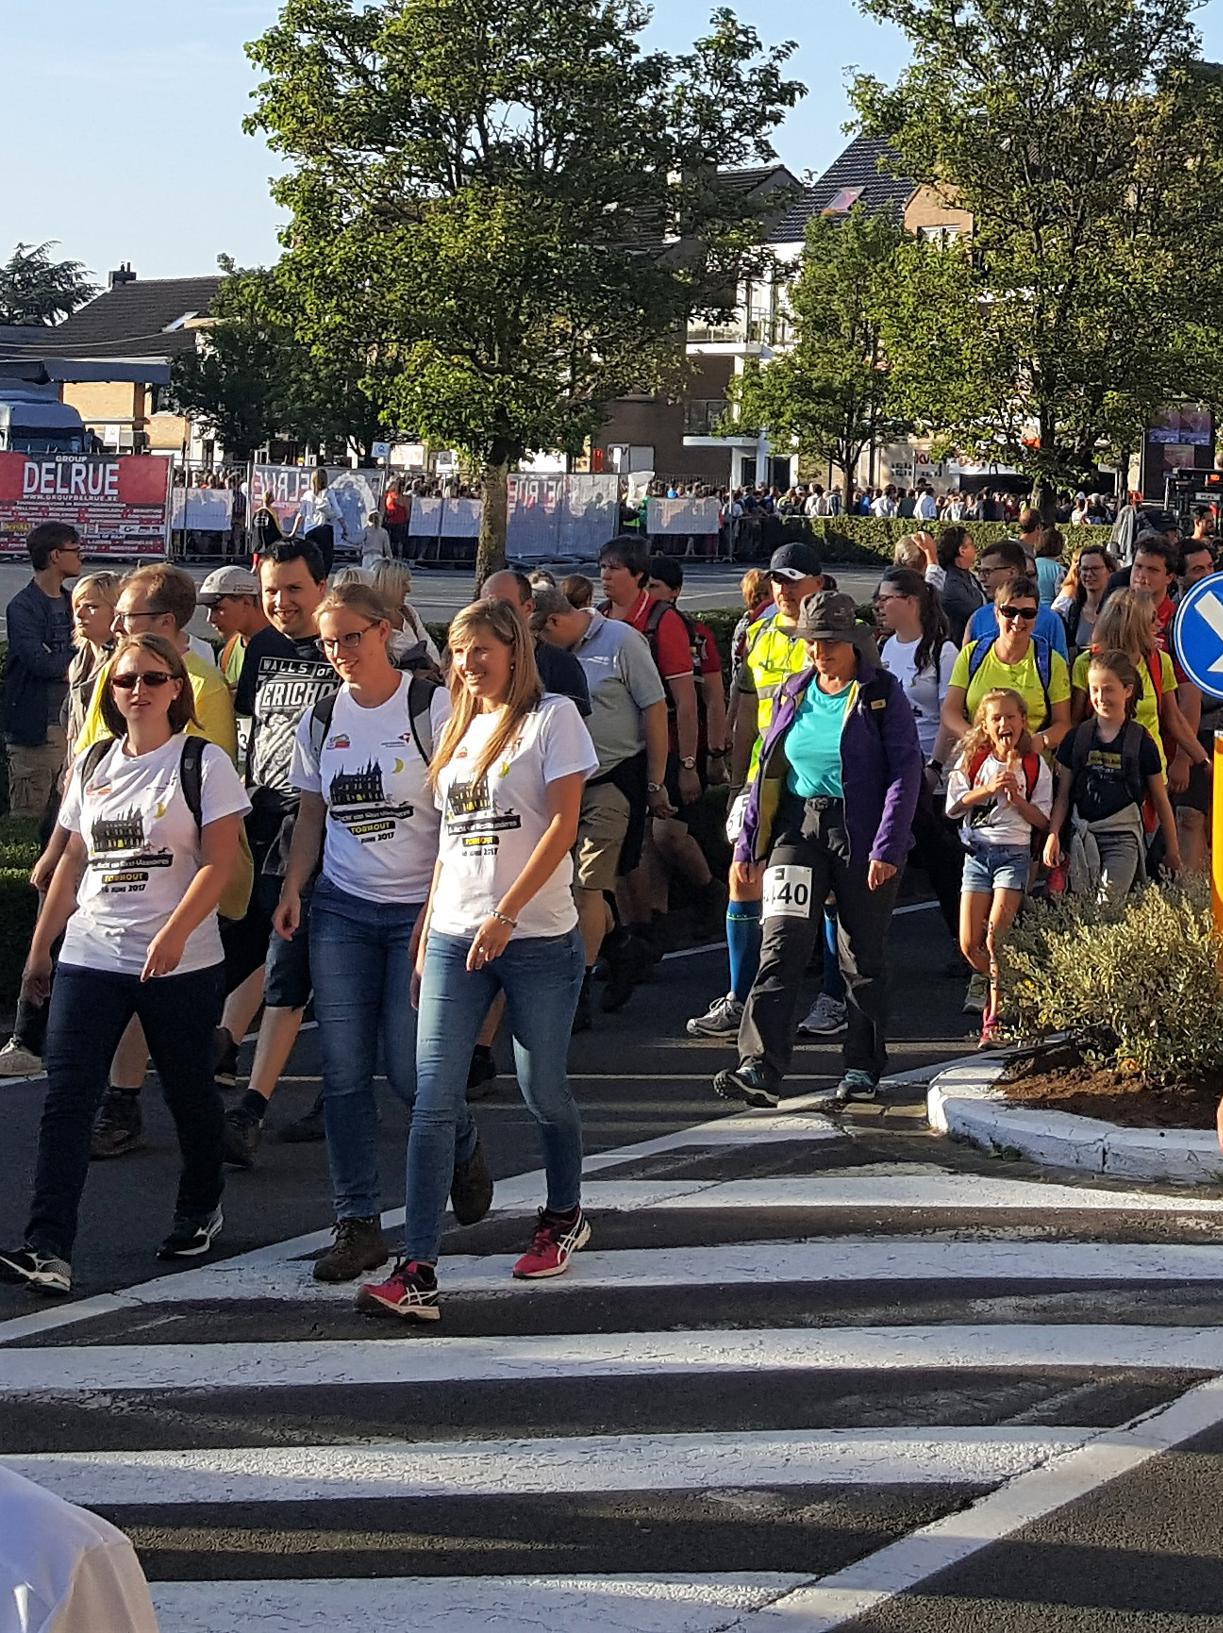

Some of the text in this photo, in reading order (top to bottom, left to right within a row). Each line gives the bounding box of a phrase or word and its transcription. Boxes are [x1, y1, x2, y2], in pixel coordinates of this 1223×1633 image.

[23, 462, 120, 494] DELRUE
[263, 660, 333, 676] WALLS OF
[378, 832, 395, 841] 2017
